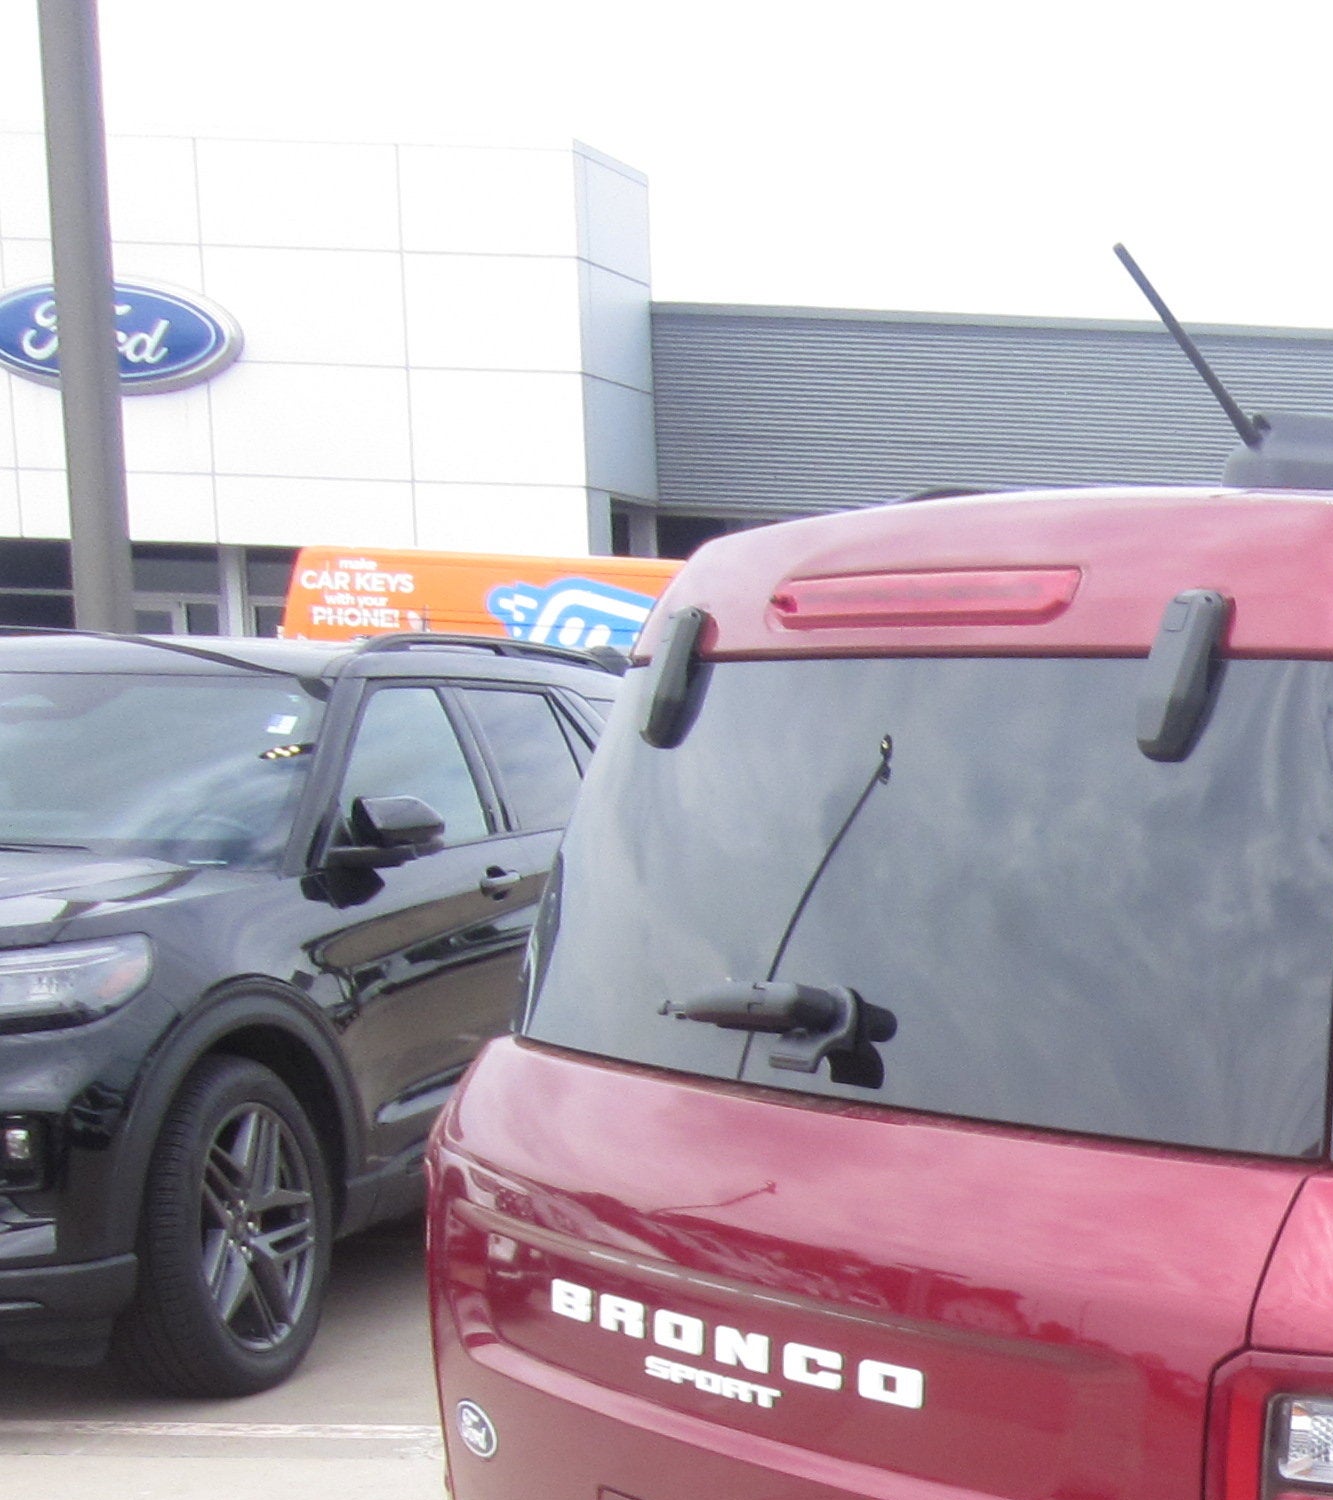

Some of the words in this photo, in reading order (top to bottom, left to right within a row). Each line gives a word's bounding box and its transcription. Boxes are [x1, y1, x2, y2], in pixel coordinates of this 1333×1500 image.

[22, 299, 171, 365] Fd
[338, 558, 378, 572] make
[301, 569, 350, 592] CAR
[354, 572, 416, 594] KEYS
[323, 592, 357, 606] with
[357, 595, 390, 609] your
[312, 605, 401, 629] PHONE!
[551, 1278, 923, 1410] BRONCO
[644, 1355, 782, 1408] SPORT
